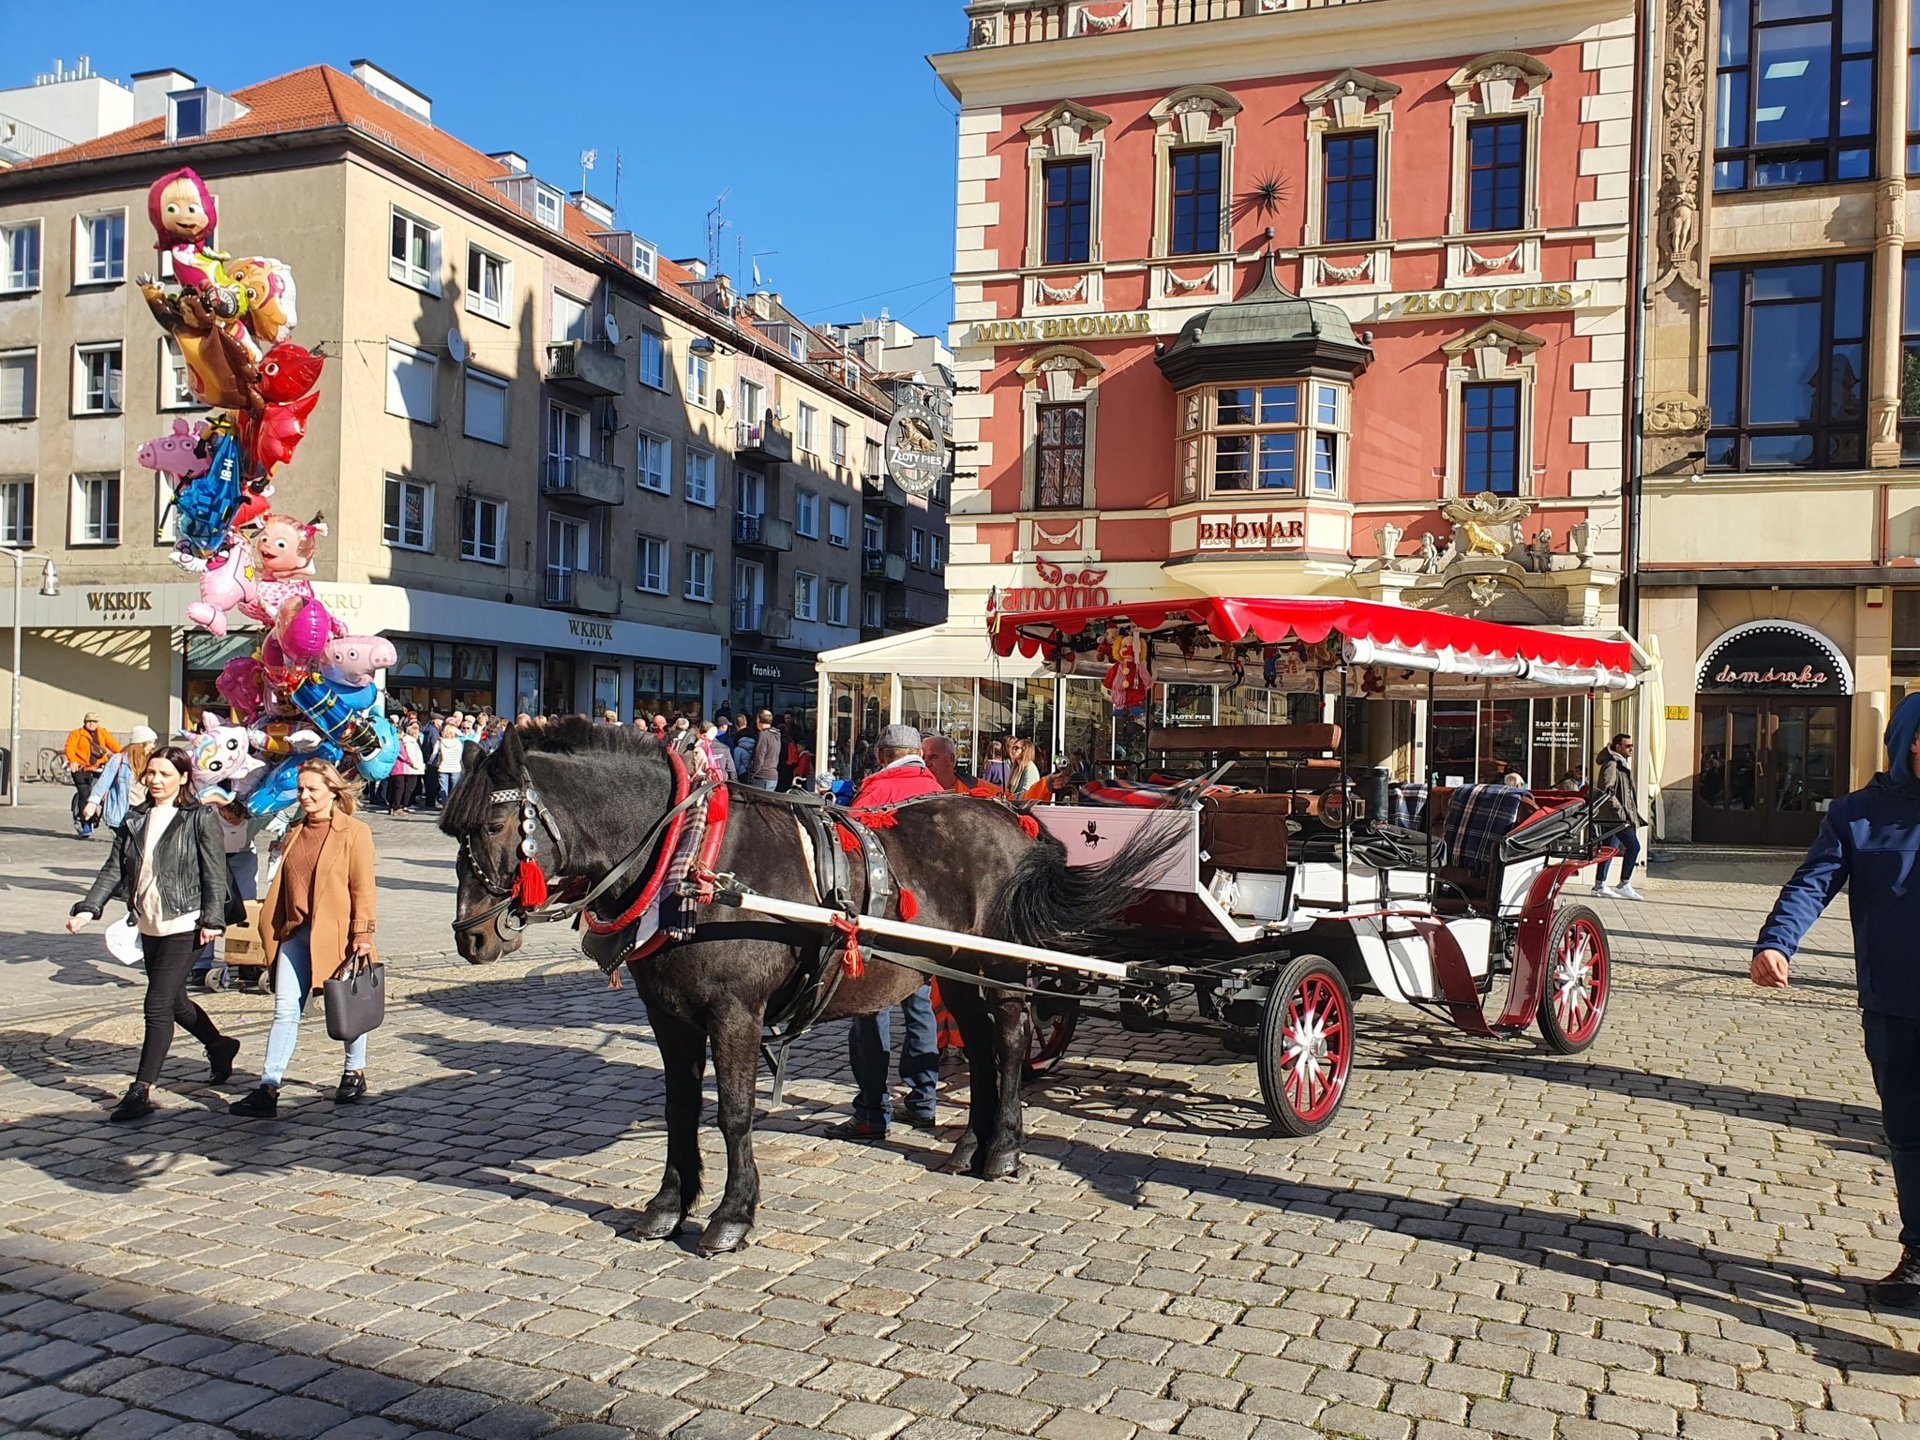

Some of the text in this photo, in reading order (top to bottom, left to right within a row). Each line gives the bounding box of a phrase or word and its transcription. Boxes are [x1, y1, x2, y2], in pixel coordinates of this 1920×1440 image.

[1403, 285, 1572, 315] ZŁOTY PIES
[977, 313, 1150, 342] MINI BROWAR
[890, 446, 942, 468] ZŁOTY PIES
[895, 471, 909, 488] MINI
[1200, 521, 1304, 539] BROWAR
[752, 663, 781, 678] frankie's
[1715, 664, 1828, 683] domówka
